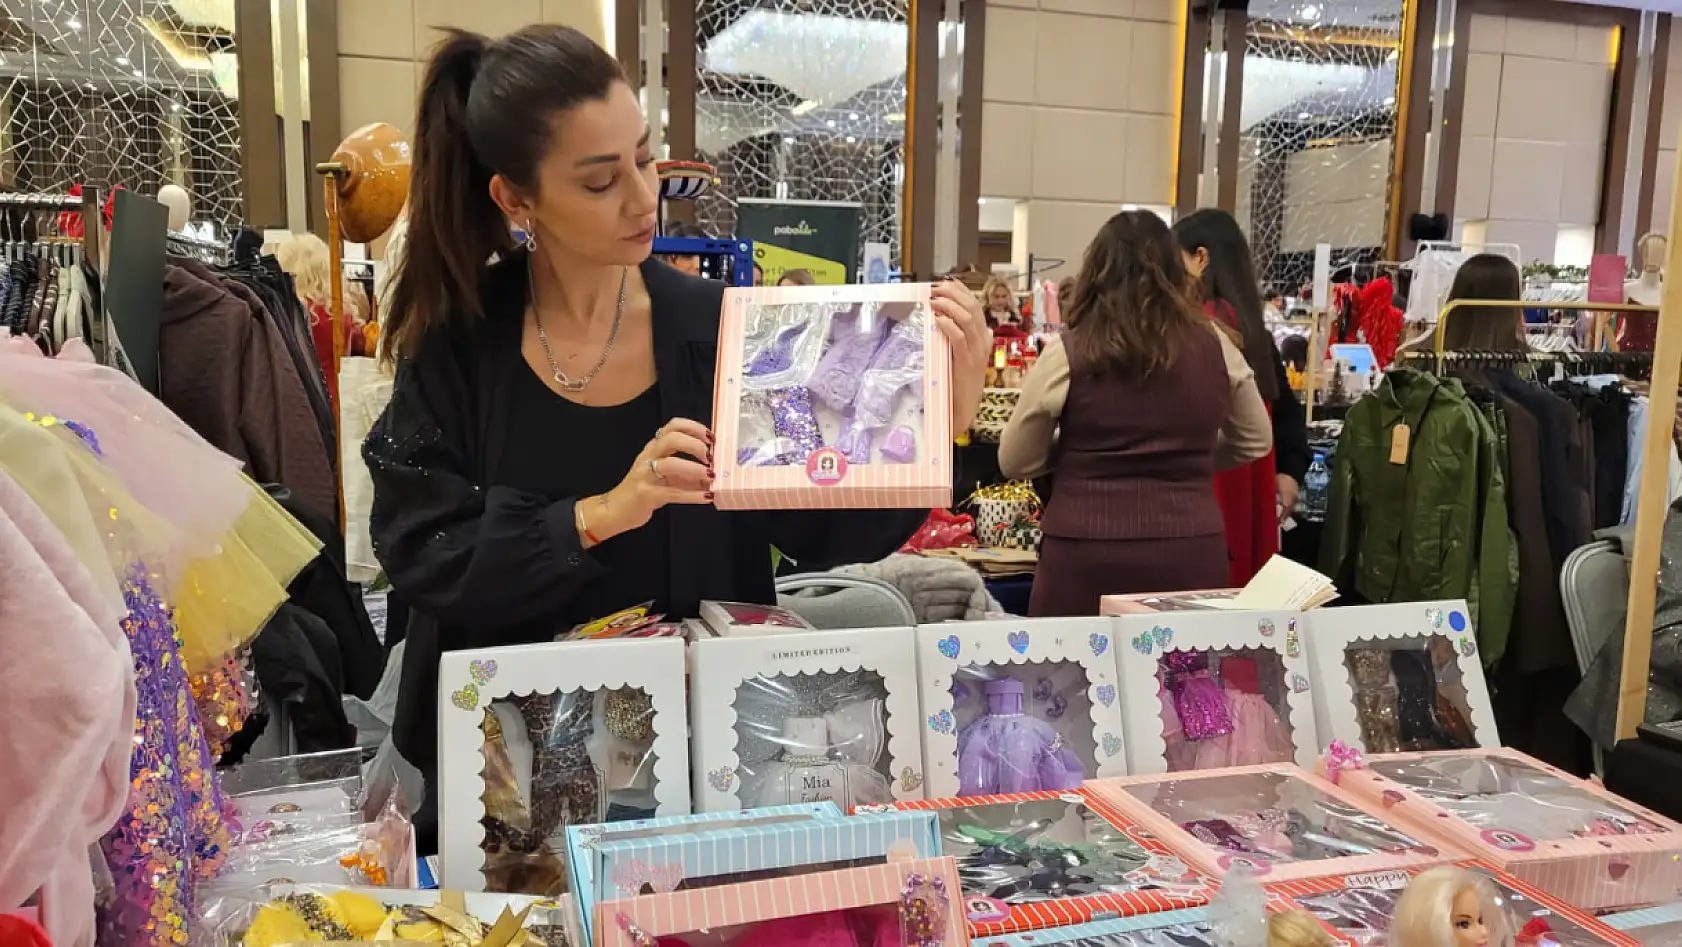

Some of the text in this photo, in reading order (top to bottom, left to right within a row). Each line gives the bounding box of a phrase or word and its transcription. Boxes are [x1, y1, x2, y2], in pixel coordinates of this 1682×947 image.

[773, 646, 851, 659] LIMITED EDITION
[801, 776, 831, 789] Mia
[1347, 871, 1408, 888] Happy
